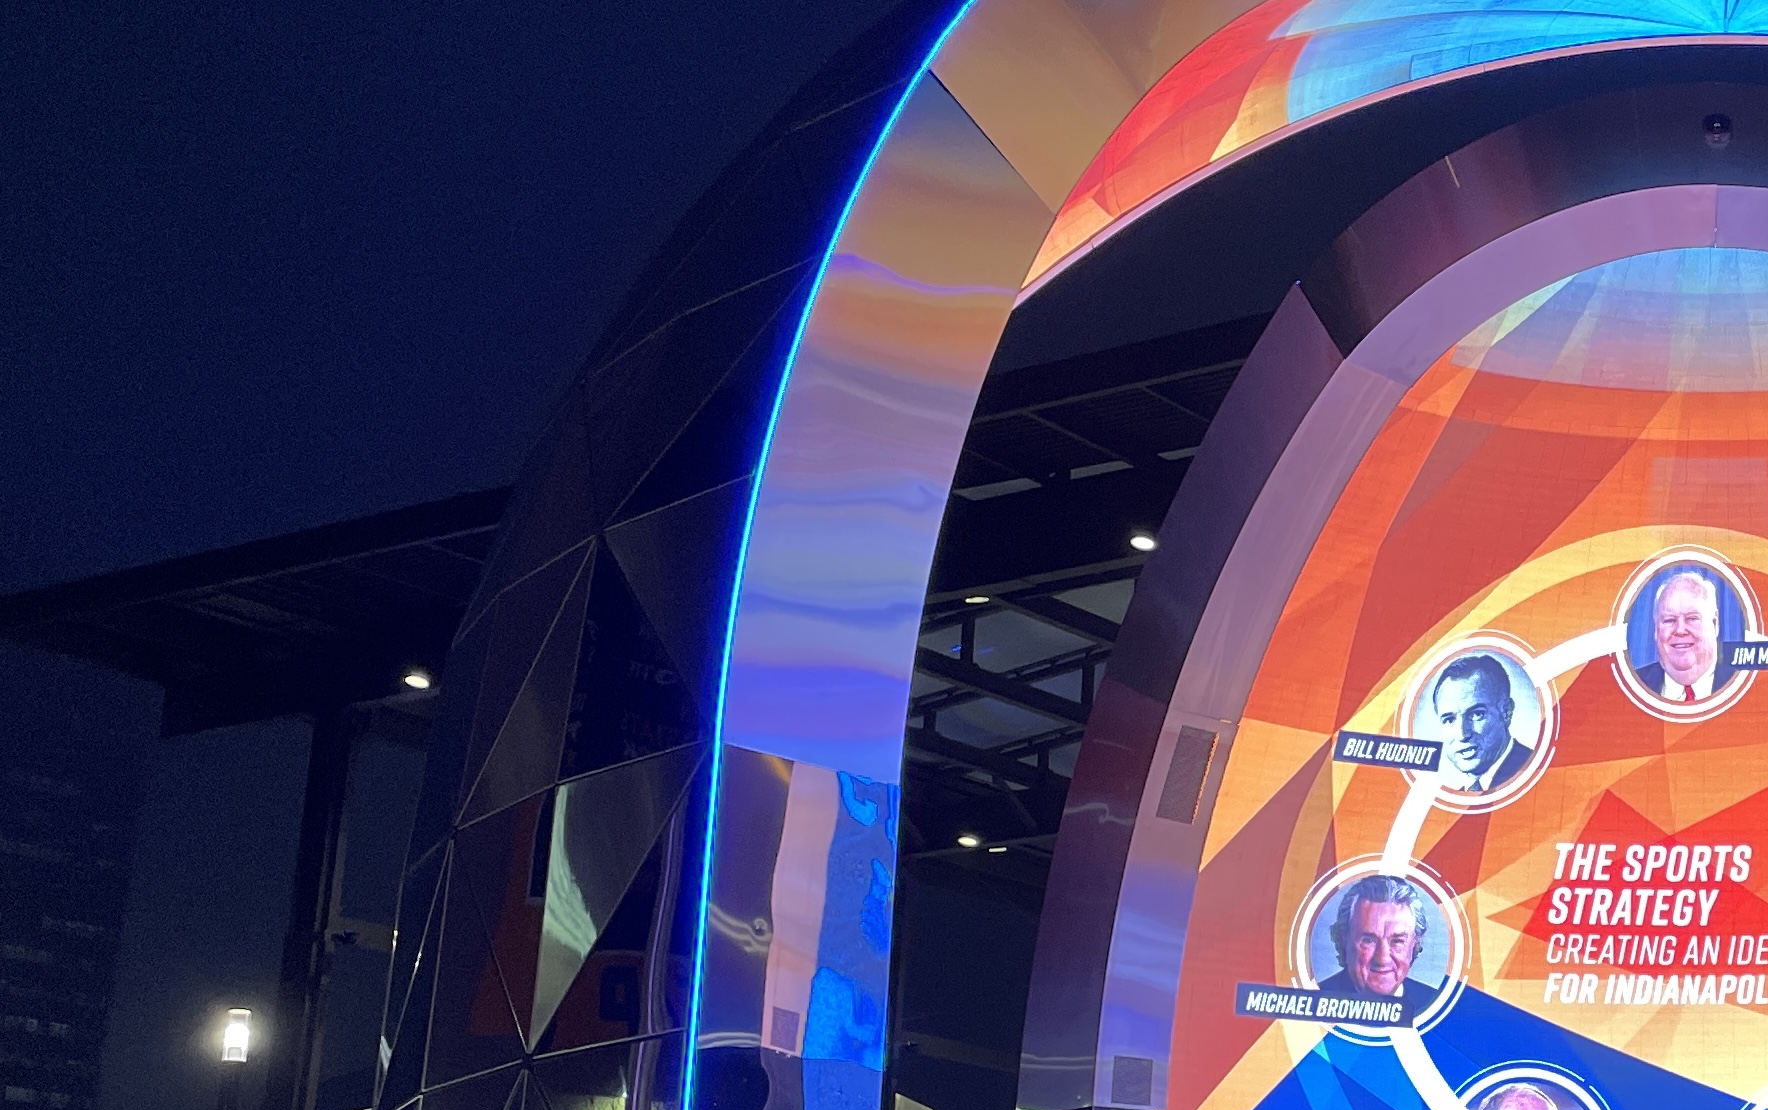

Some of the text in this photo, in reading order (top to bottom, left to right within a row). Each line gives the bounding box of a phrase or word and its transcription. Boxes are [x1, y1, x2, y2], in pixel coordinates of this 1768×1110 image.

[1731, 647, 1756, 665] JIM
[1342, 738, 1438, 765] BILL HUDNUT
[1553, 842, 1752, 883] THE SPORTS
[1548, 886, 1719, 927] STRATEGY
[1546, 933, 1678, 966] CREATING
[1682, 935, 1721, 965] AN
[1543, 972, 1600, 1005] FOR
[1246, 991, 1403, 1022] MICHAEL BROWNING
